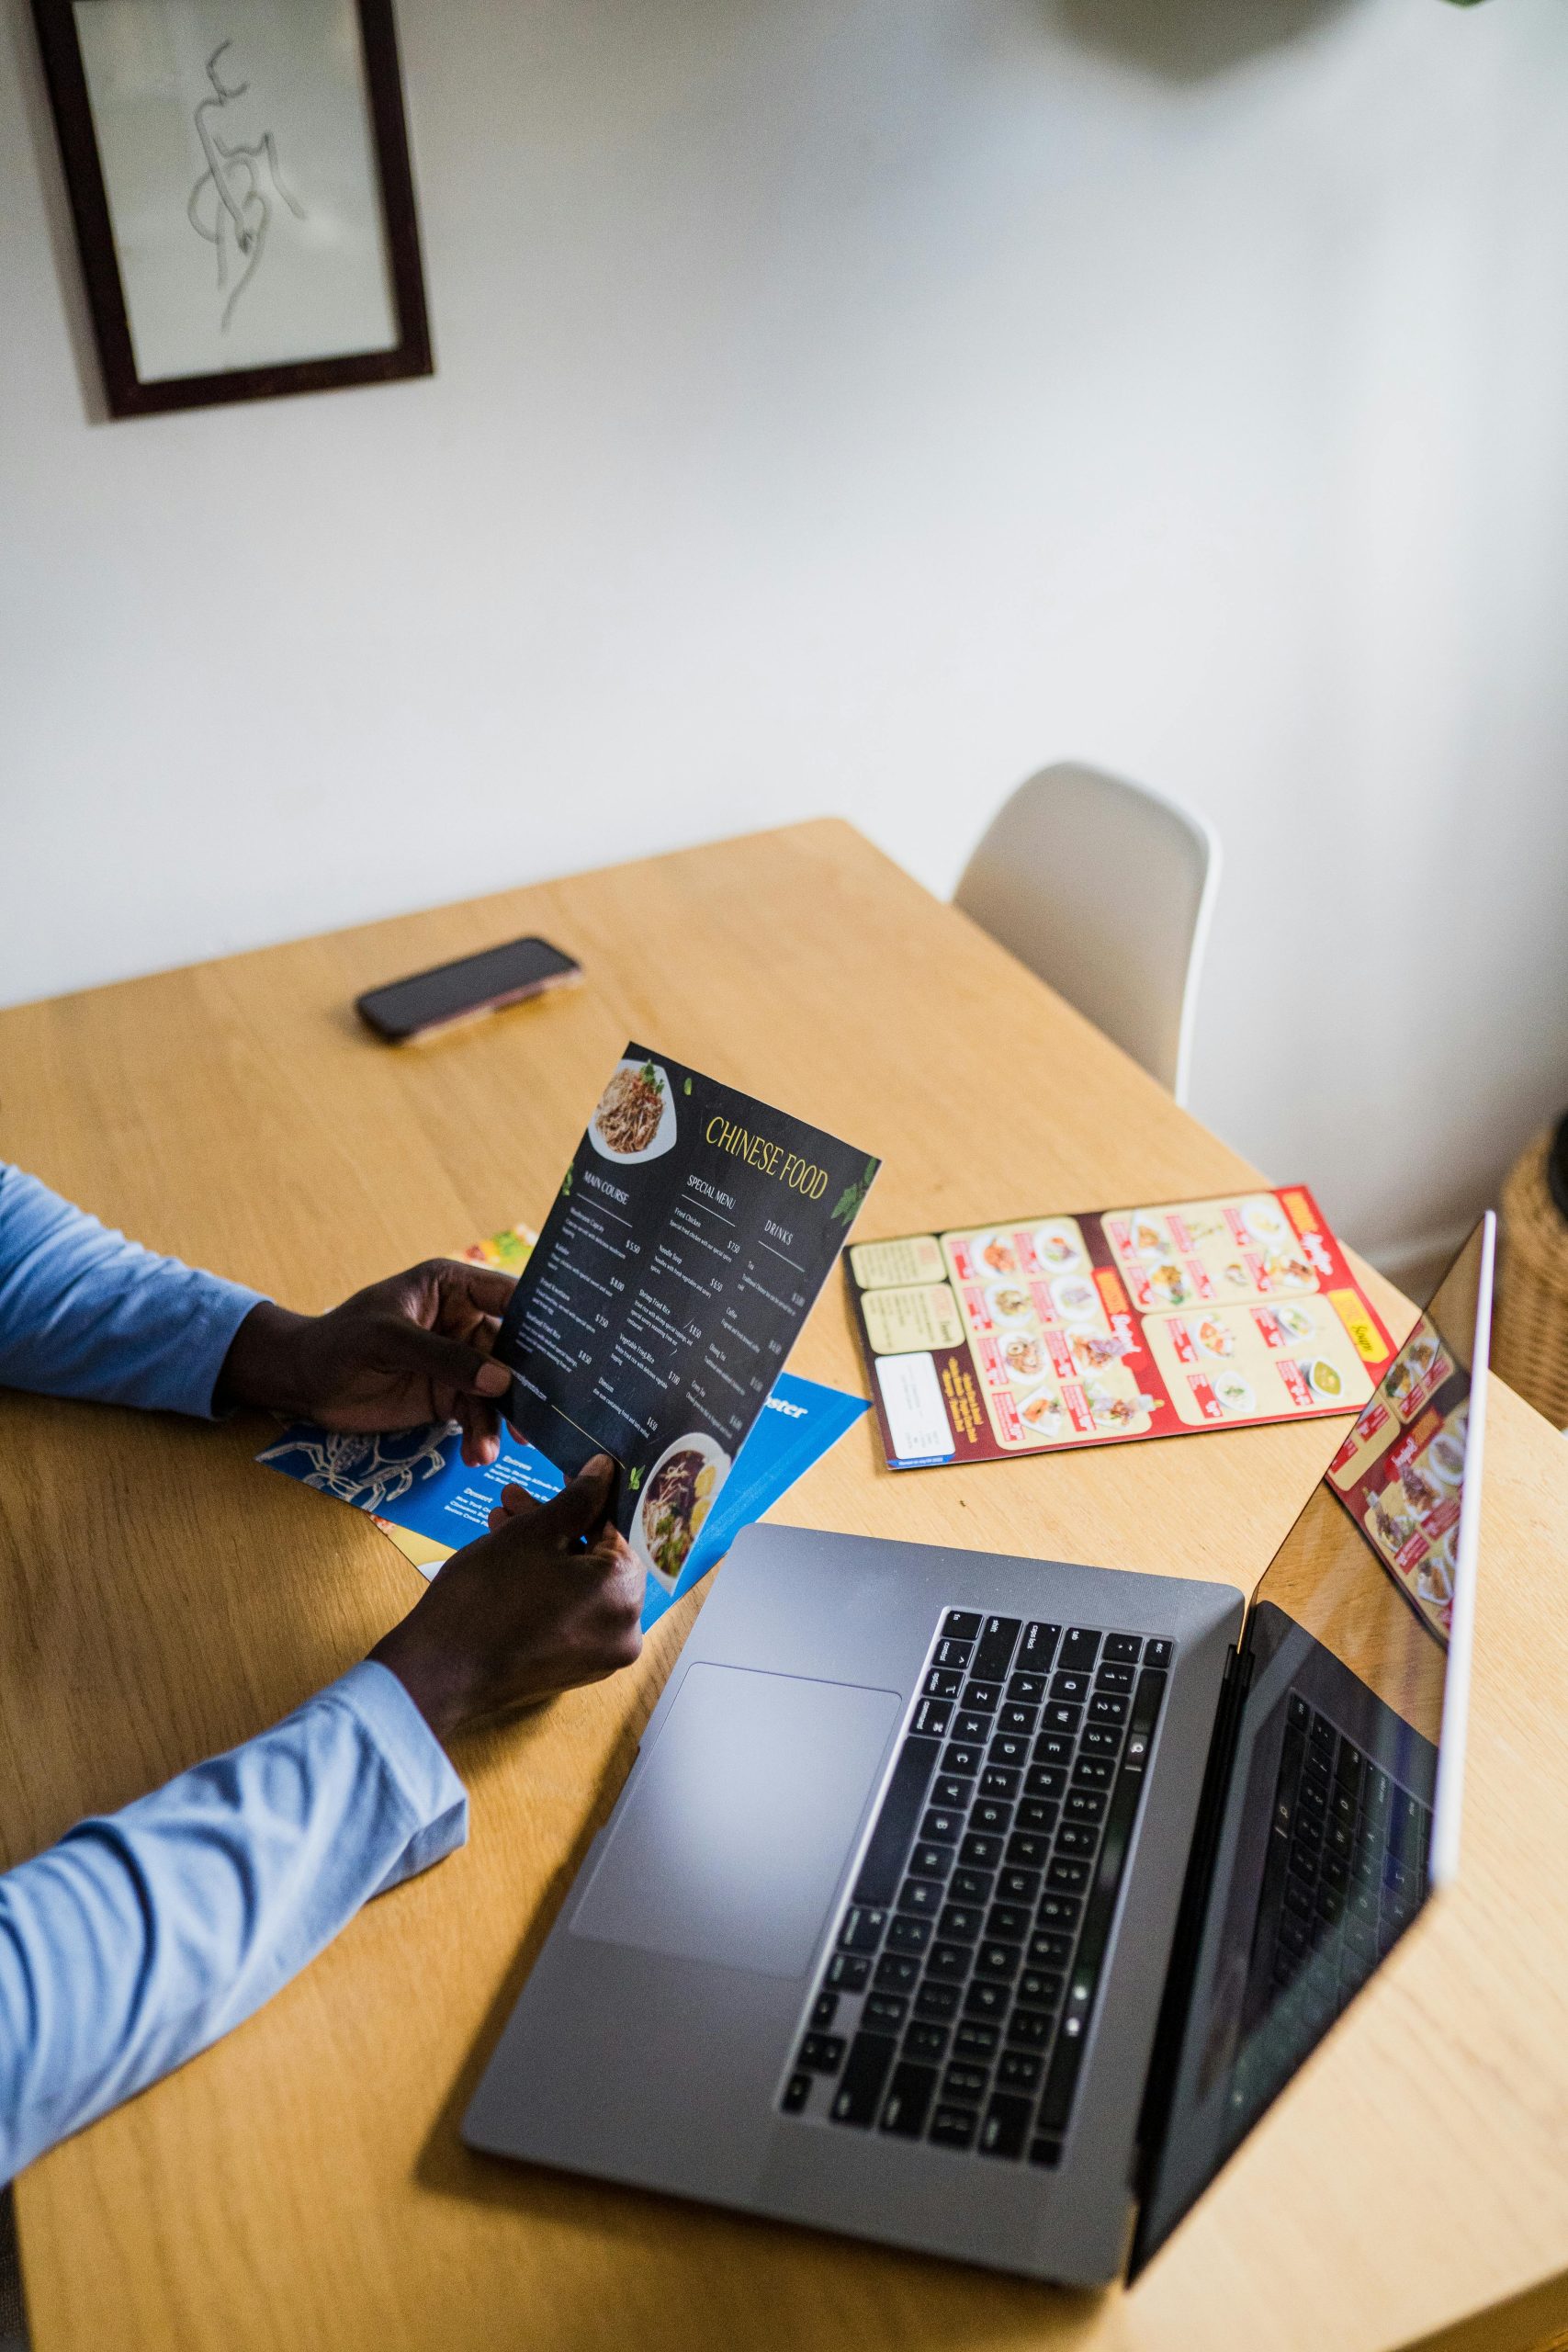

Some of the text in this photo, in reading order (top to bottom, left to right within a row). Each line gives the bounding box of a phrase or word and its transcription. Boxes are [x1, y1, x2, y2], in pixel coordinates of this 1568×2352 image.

[705, 1116, 829, 1200] CHINESE FOOD
[582, 1170, 629, 1204] MAIN COURSE
[687, 1174, 737, 1210] SPECIAL MENU
[675, 1207, 701, 1227] Fried Chicken
[670, 1220, 682, 1230] Special
[682, 1227, 690, 1235] fried
[689, 1233, 701, 1242] chicken
[713, 1248, 724, 1257] special
[723, 1254, 732, 1262] spices
[764, 1220, 794, 1246] DRINKS
[660, 1245, 682, 1265] Noodle Soup
[650, 1265, 660, 1274] spices
[655, 1256, 667, 1268] Noodles
[674, 1269, 682, 1277] fresh
[682, 1275, 697, 1288] vegetables
[702, 1289, 711, 1298] savory
[639, 1289, 671, 1315] Shrimp Fried Rice
[727, 1307, 737, 1319] Coffee
[631, 1310, 642, 1319] special
[651, 1325, 666, 1339] seasoning
[665, 1323, 676, 1332] special
[620, 1333, 655, 1363] Vegetable Fried Rice
[615, 1344, 624, 1354] White
[624, 1351, 632, 1360] fried
[643, 1366, 656, 1379] delicious
[656, 1377, 668, 1389] vegetable
[599, 1377, 614, 1393] Dimsum
[692, 1380, 700, 1392] Green
[606, 1399, 622, 1415] containing
[621, 1410, 629, 1419] fresh
[464, 1487, 493, 1503] Dessert
[469, 1501, 482, 1510] York
[989, 1620, 998, 1632] shift
[1027, 1625, 1038, 1649] caps lock
[937, 1640, 950, 1661] control
[930, 1672, 940, 1690] option
[1065, 1681, 1076, 1690] Q
[917, 1701, 931, 1730] command
[1058, 1712, 1068, 1722] W
[967, 1723, 977, 1731] X
[1004, 1745, 1015, 1753] D
[957, 1754, 968, 1762] C
[997, 1777, 1006, 1785] F
[1041, 1776, 1051, 1784] R
[948, 1787, 958, 1796] V
[985, 1810, 996, 1819] G
[937, 1820, 948, 1828] B
